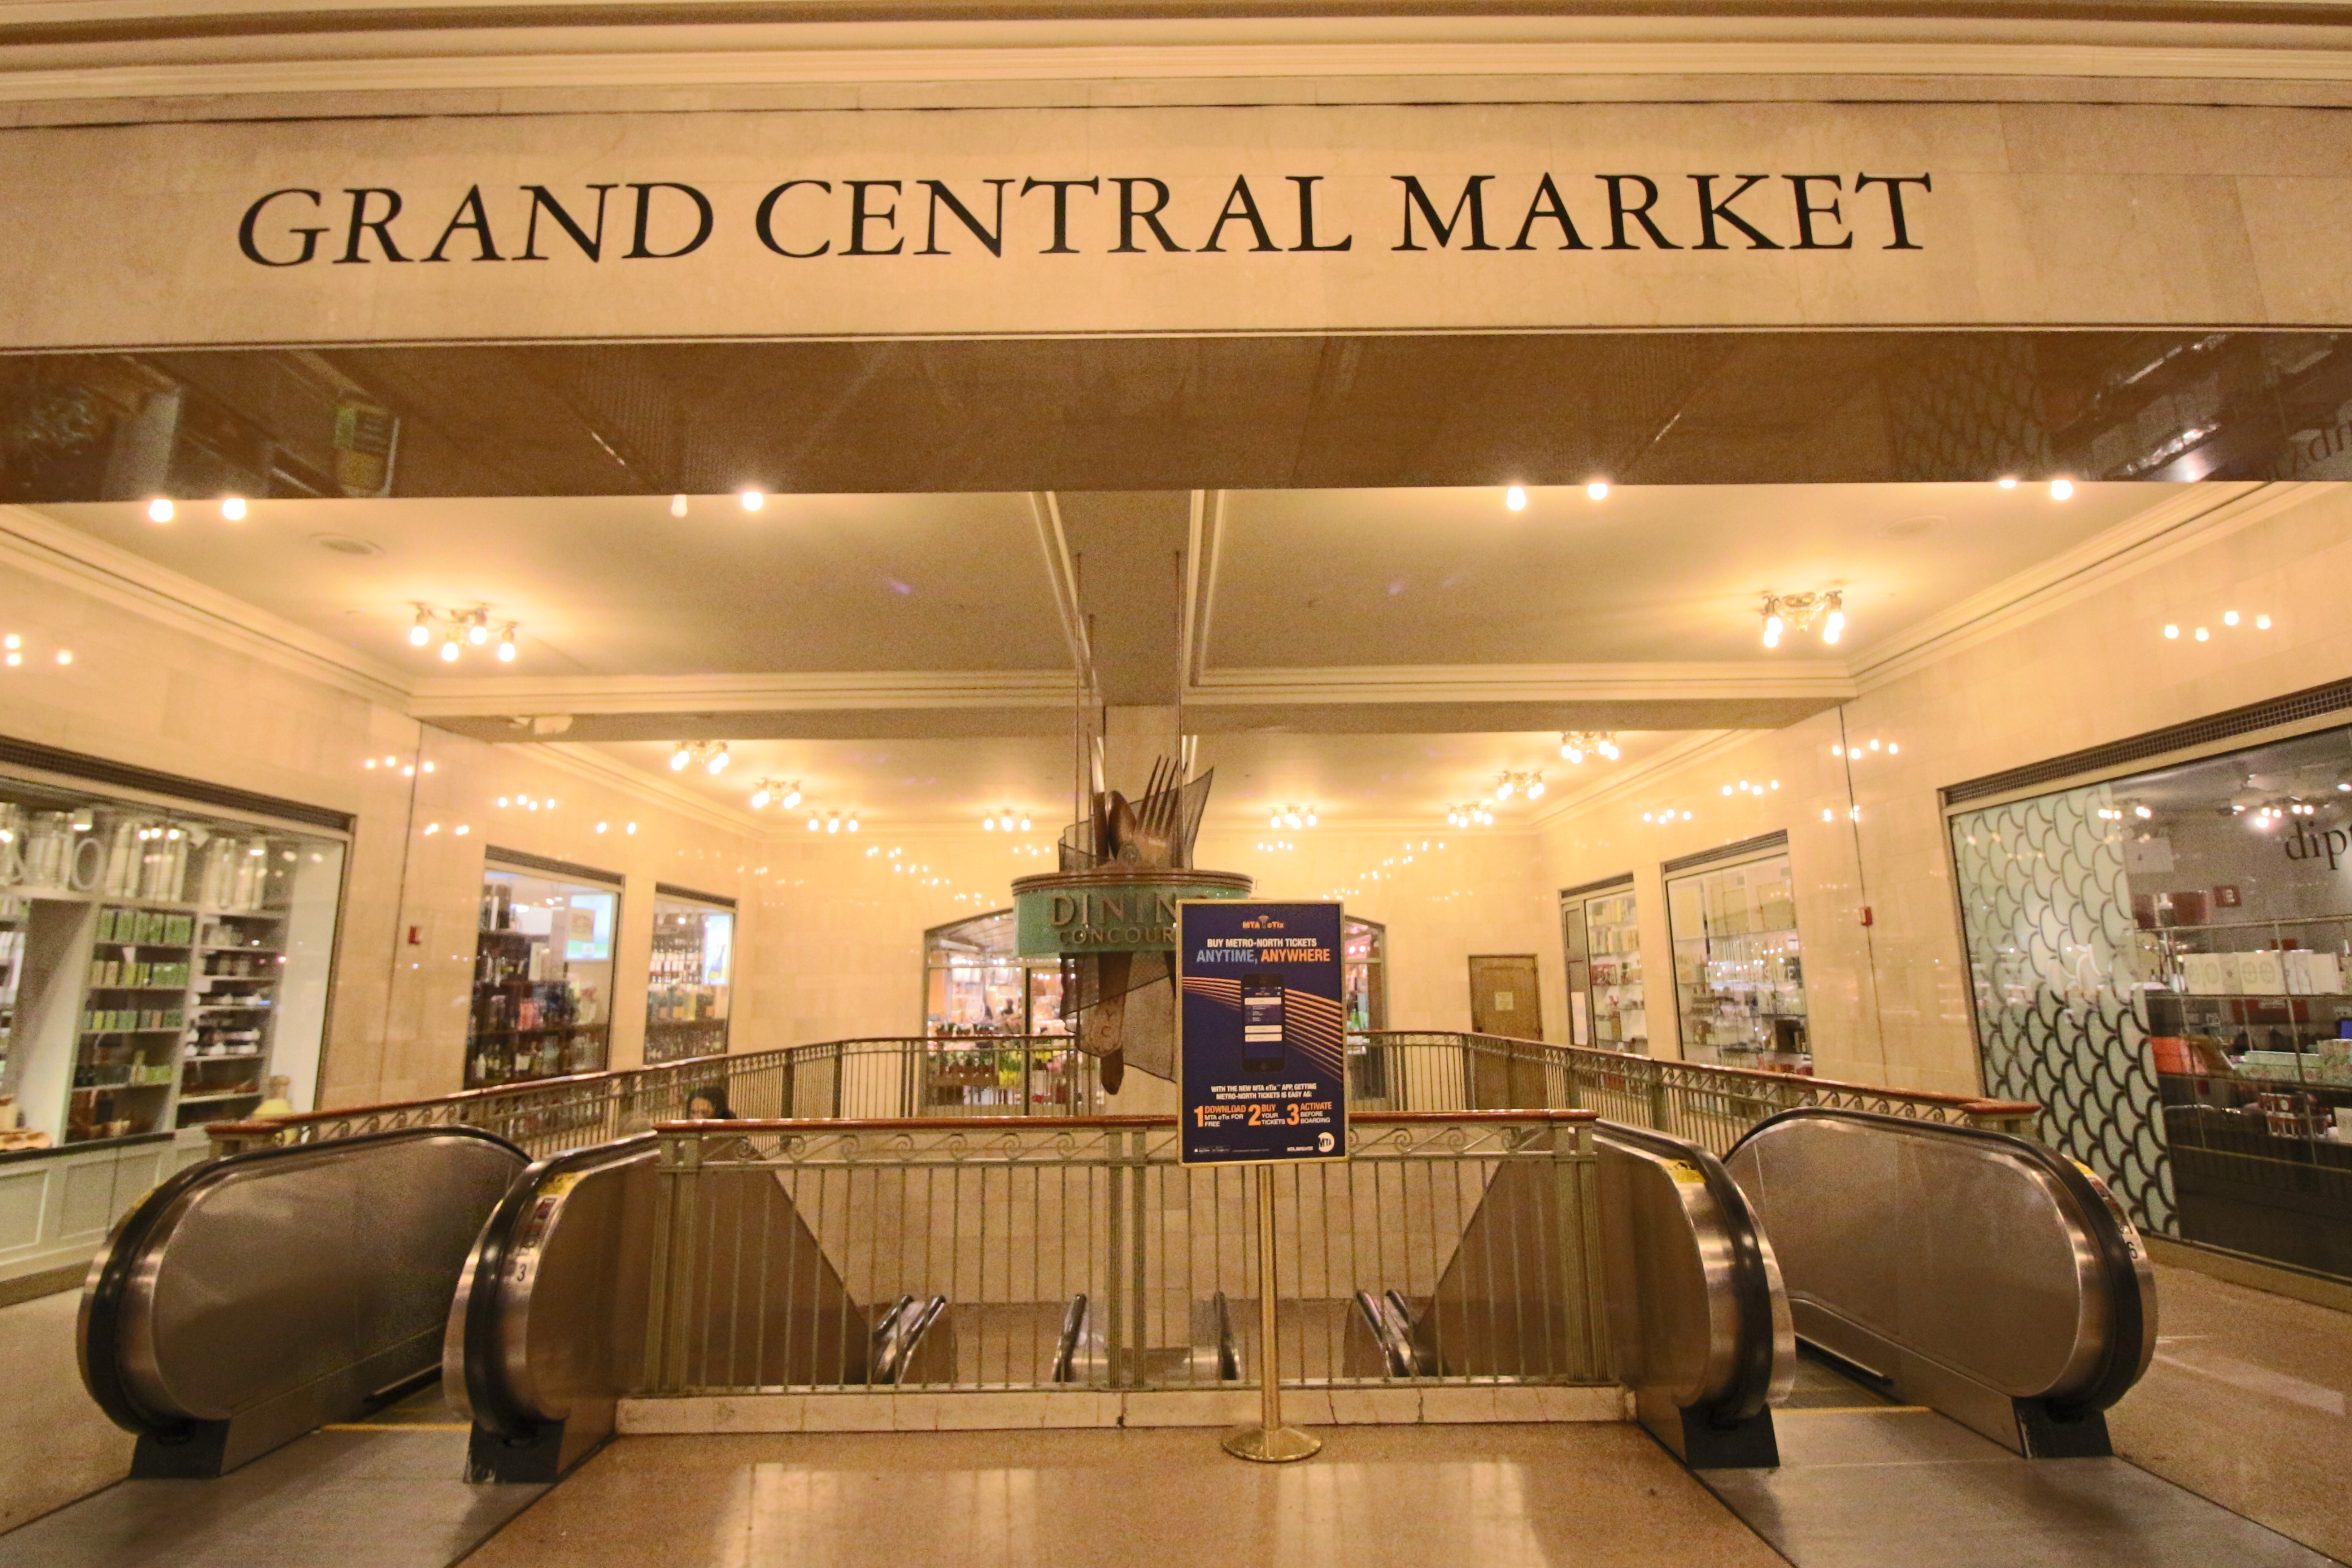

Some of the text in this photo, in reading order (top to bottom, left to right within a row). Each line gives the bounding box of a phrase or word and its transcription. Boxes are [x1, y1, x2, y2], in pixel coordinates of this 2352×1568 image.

[238, 172, 1932, 267] GRAND CENTRAL MARKET
[2285, 819, 2352, 870] dip
[1053, 891, 1176, 926] DININ
[1059, 927, 1176, 945] CONCOUR
[1207, 938, 1317, 948] BUY METRO-NORTH TICKETS
[1196, 948, 1330, 965] ANYTIME, ANYWHERE
[1205, 1104, 1246, 1114] DOWNLOAD
[1248, 1104, 1261, 1126] 2
[1287, 1103, 1299, 1125] 3
[1300, 1102, 1333, 1111] ACTIVATE
[1194, 1105, 1203, 1127] 1
[1318, 1138, 1333, 1148] MTA
[517, 1264, 527, 1282] 3
